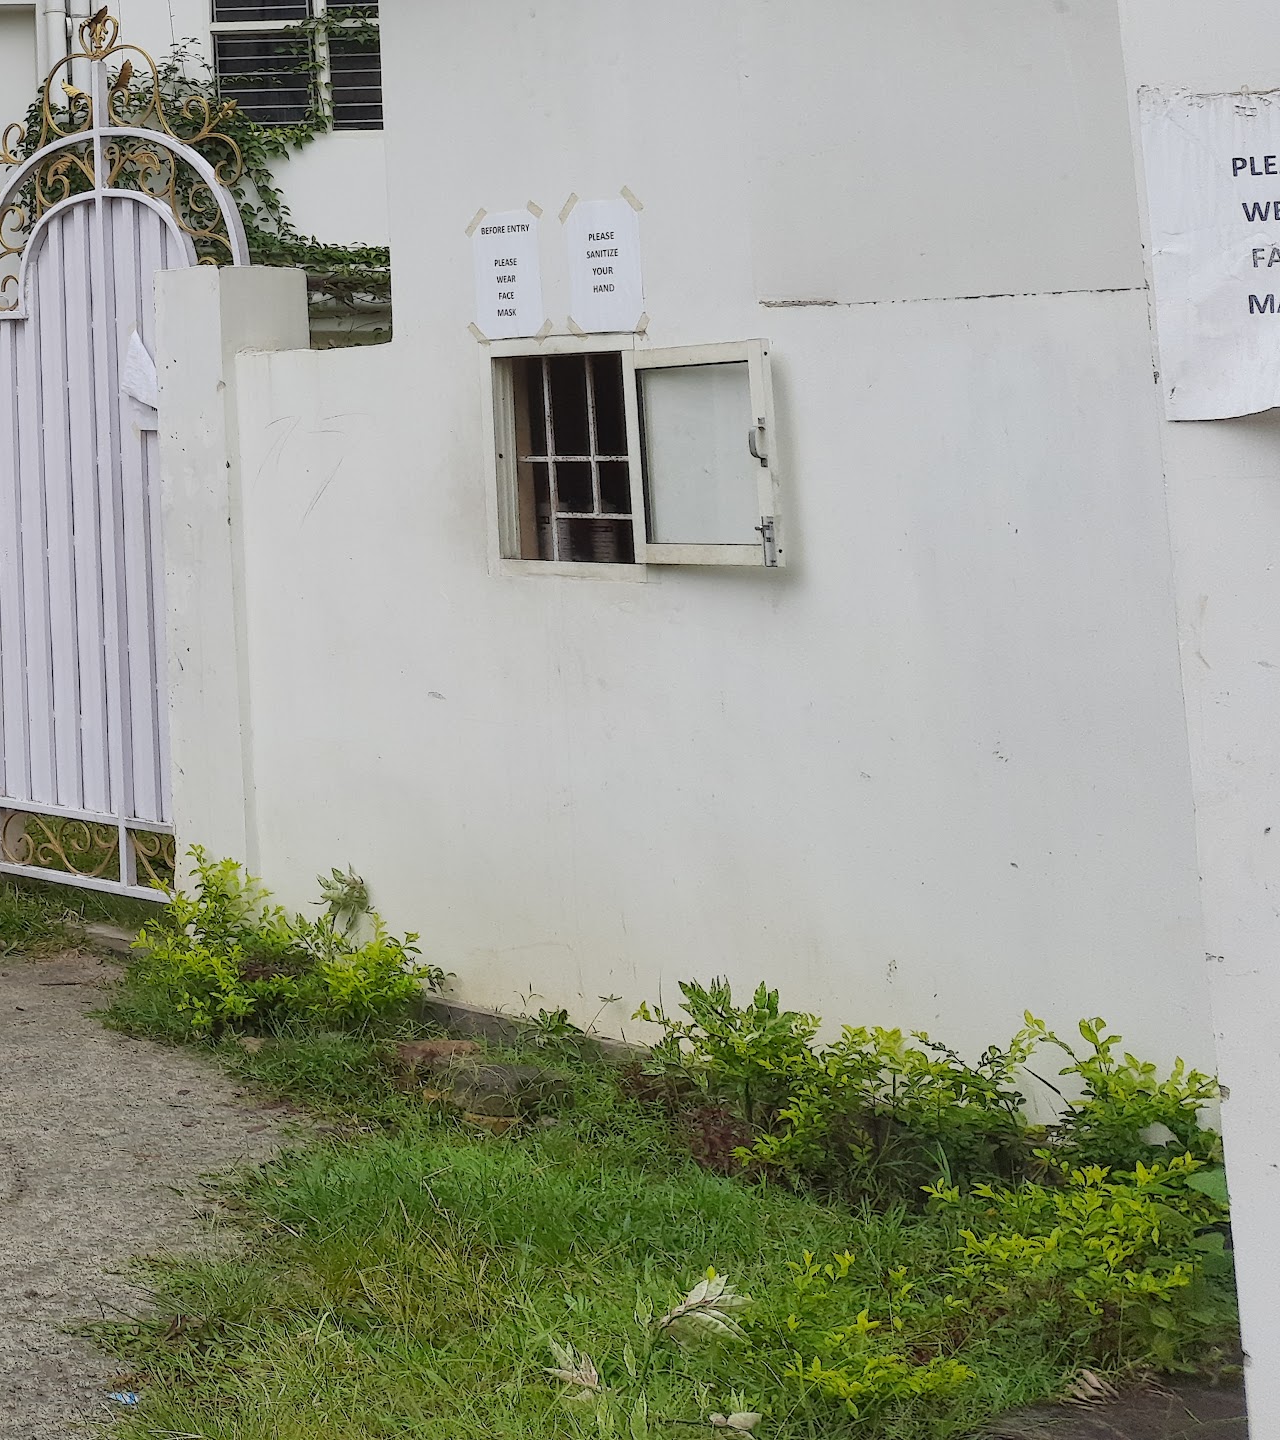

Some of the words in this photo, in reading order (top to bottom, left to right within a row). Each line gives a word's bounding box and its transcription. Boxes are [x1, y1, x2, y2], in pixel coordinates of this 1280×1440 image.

[1231, 154, 1280, 177] PLE
[481, 225, 505, 235] BEFORE
[507, 224, 530, 233] ENTRY
[588, 231, 615, 241] PLEASE
[586, 248, 618, 259] SANITIZE
[494, 258, 517, 267] PLEASE
[592, 266, 613, 276] YOUR
[496, 274, 516, 284] WEAR
[593, 283, 615, 293] HAND
[498, 291, 515, 300] FACE
[1248, 293, 1280, 314] M
[497, 308, 517, 317] MASK
